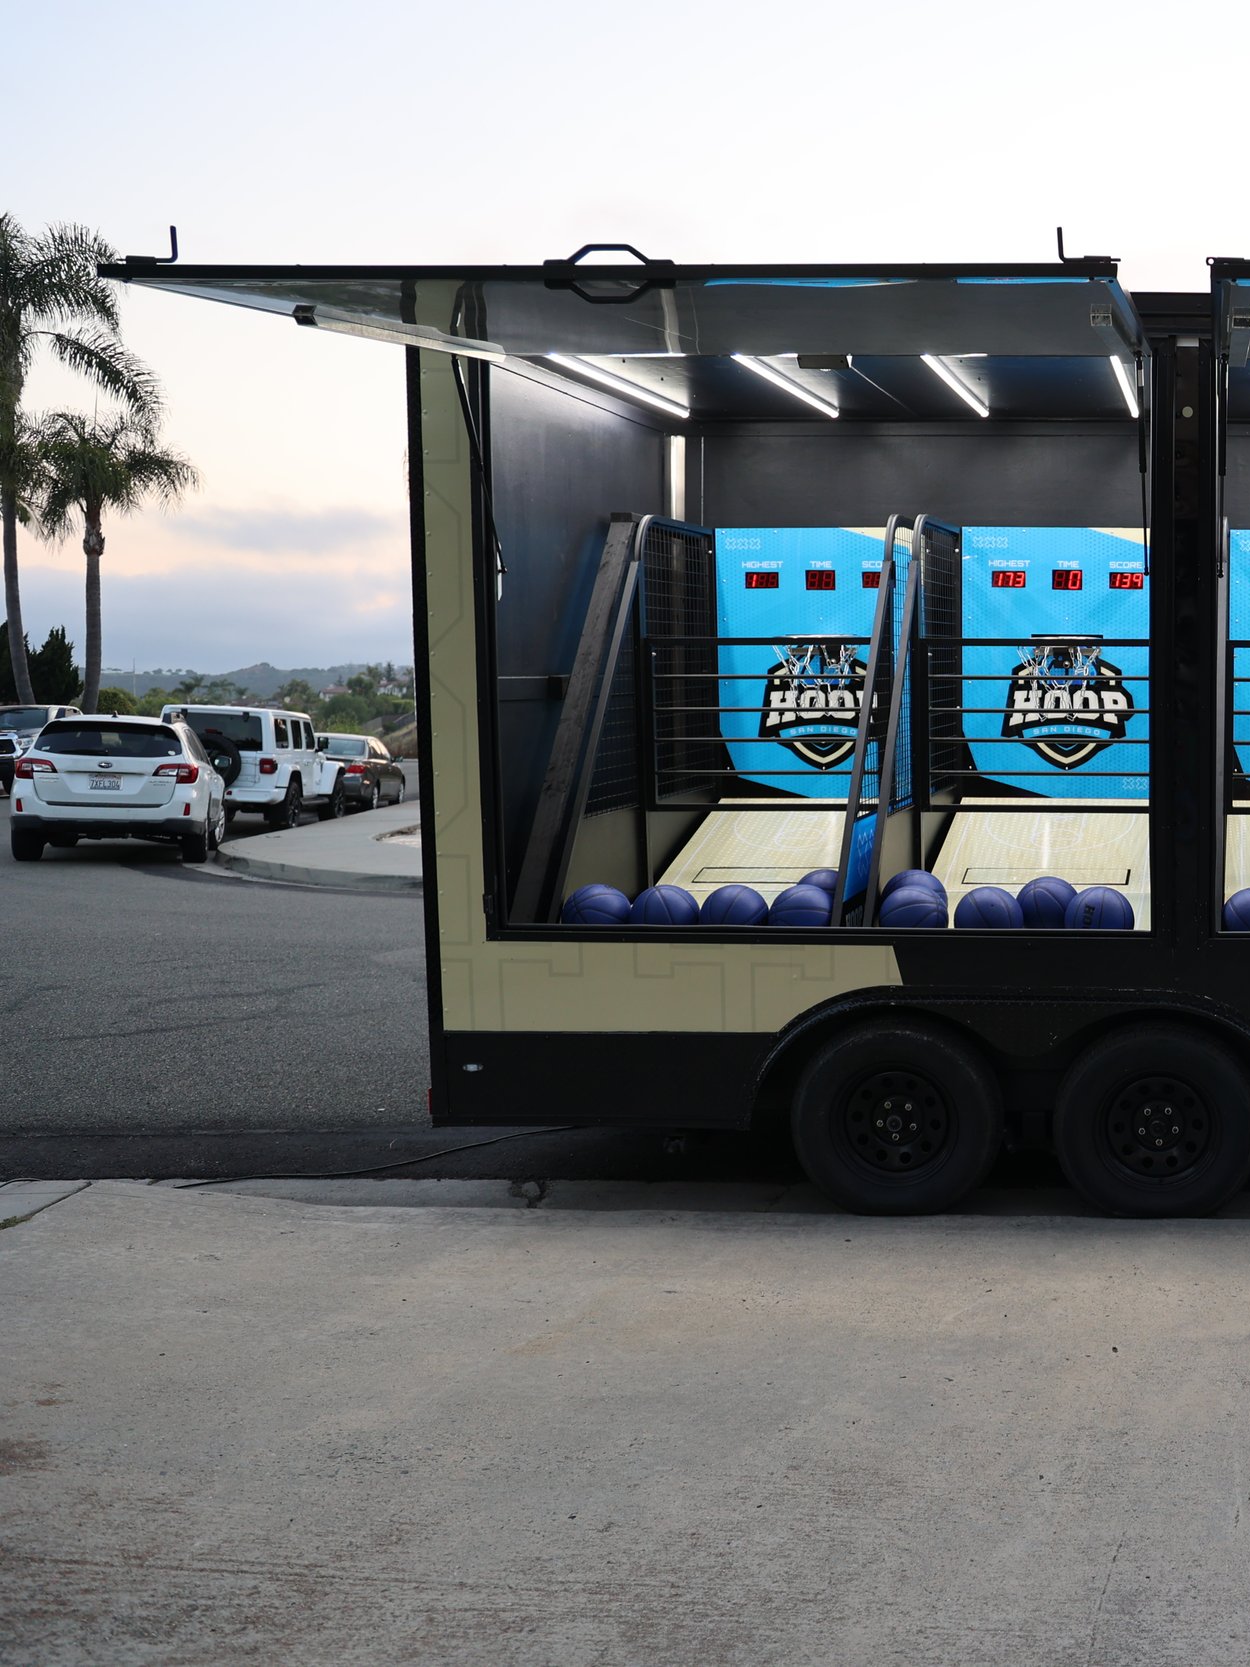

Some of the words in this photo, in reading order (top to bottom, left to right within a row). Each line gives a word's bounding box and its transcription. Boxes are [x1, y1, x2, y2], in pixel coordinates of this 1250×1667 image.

[742, 560, 783, 568] HIGHEST
[810, 560, 832, 568] TIME
[862, 560, 882, 568] SCO
[988, 559, 1030, 568] HIGHEST
[1057, 560, 1079, 568] TIME
[1109, 561, 1143, 569] SCORE
[998, 572, 1025, 587] 173
[1068, 570, 1081, 590] 0
[1115, 573, 1143, 588] 139
[1009, 690, 1128, 727] HOOP
[790, 726, 814, 735] SAN
[821, 726, 857, 735] DIEGO
[1033, 726, 1057, 735] SAN
[1064, 726, 1100, 735] DIEGO
